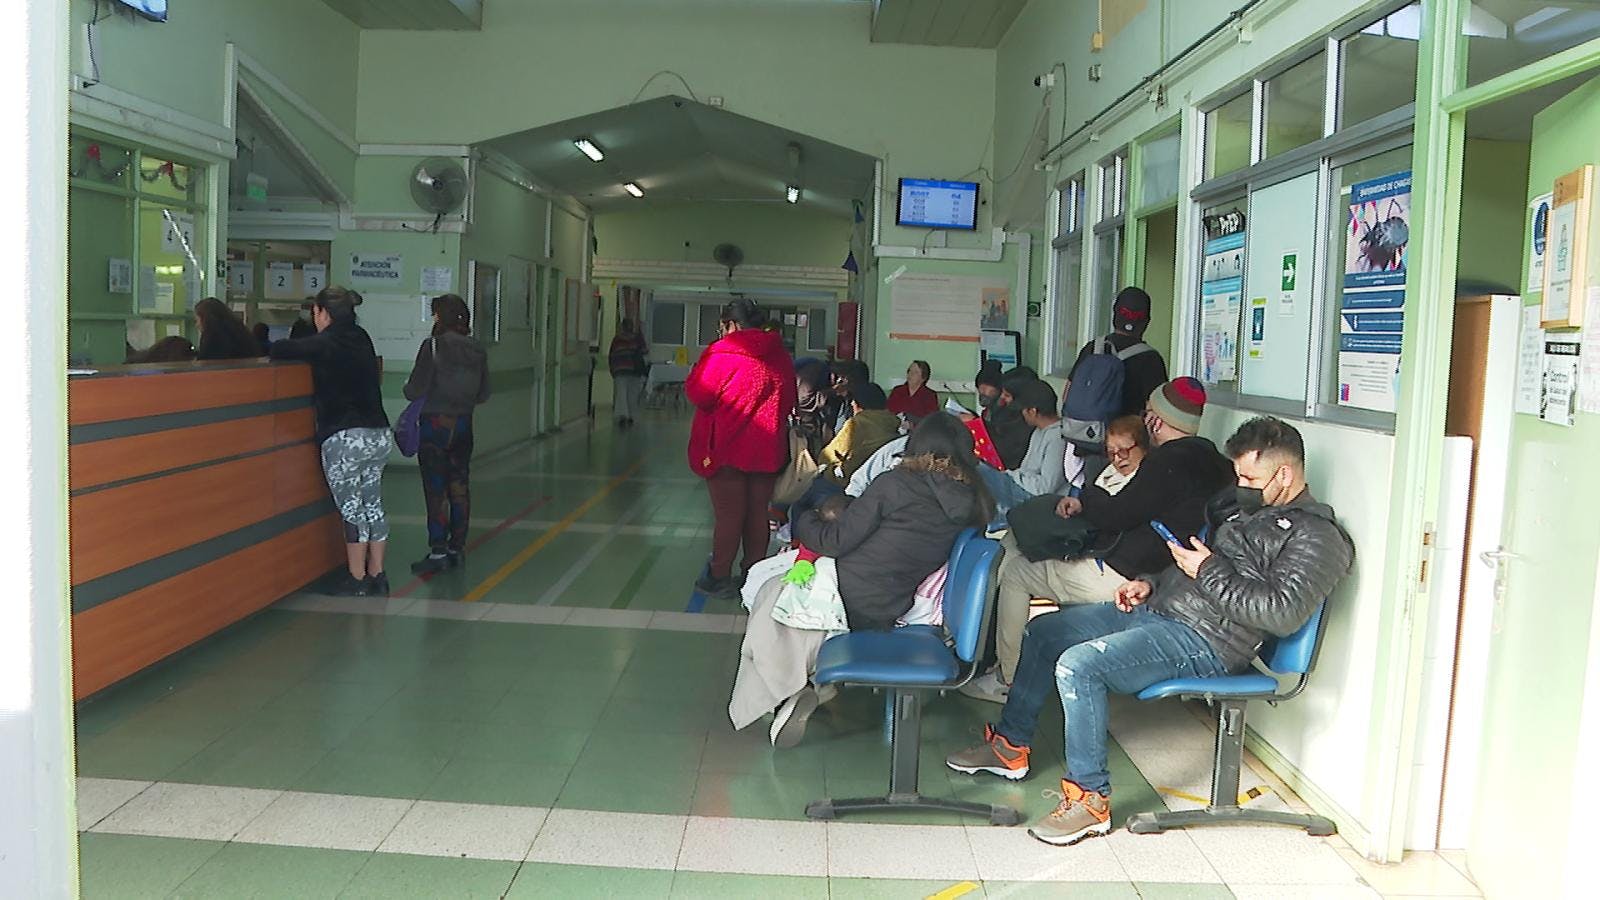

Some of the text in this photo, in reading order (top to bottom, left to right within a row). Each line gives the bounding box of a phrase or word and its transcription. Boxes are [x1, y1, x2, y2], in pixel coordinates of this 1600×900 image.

[239, 273, 245, 285] 1
[277, 275, 285, 287] 2
[310, 276, 318, 288] 3
